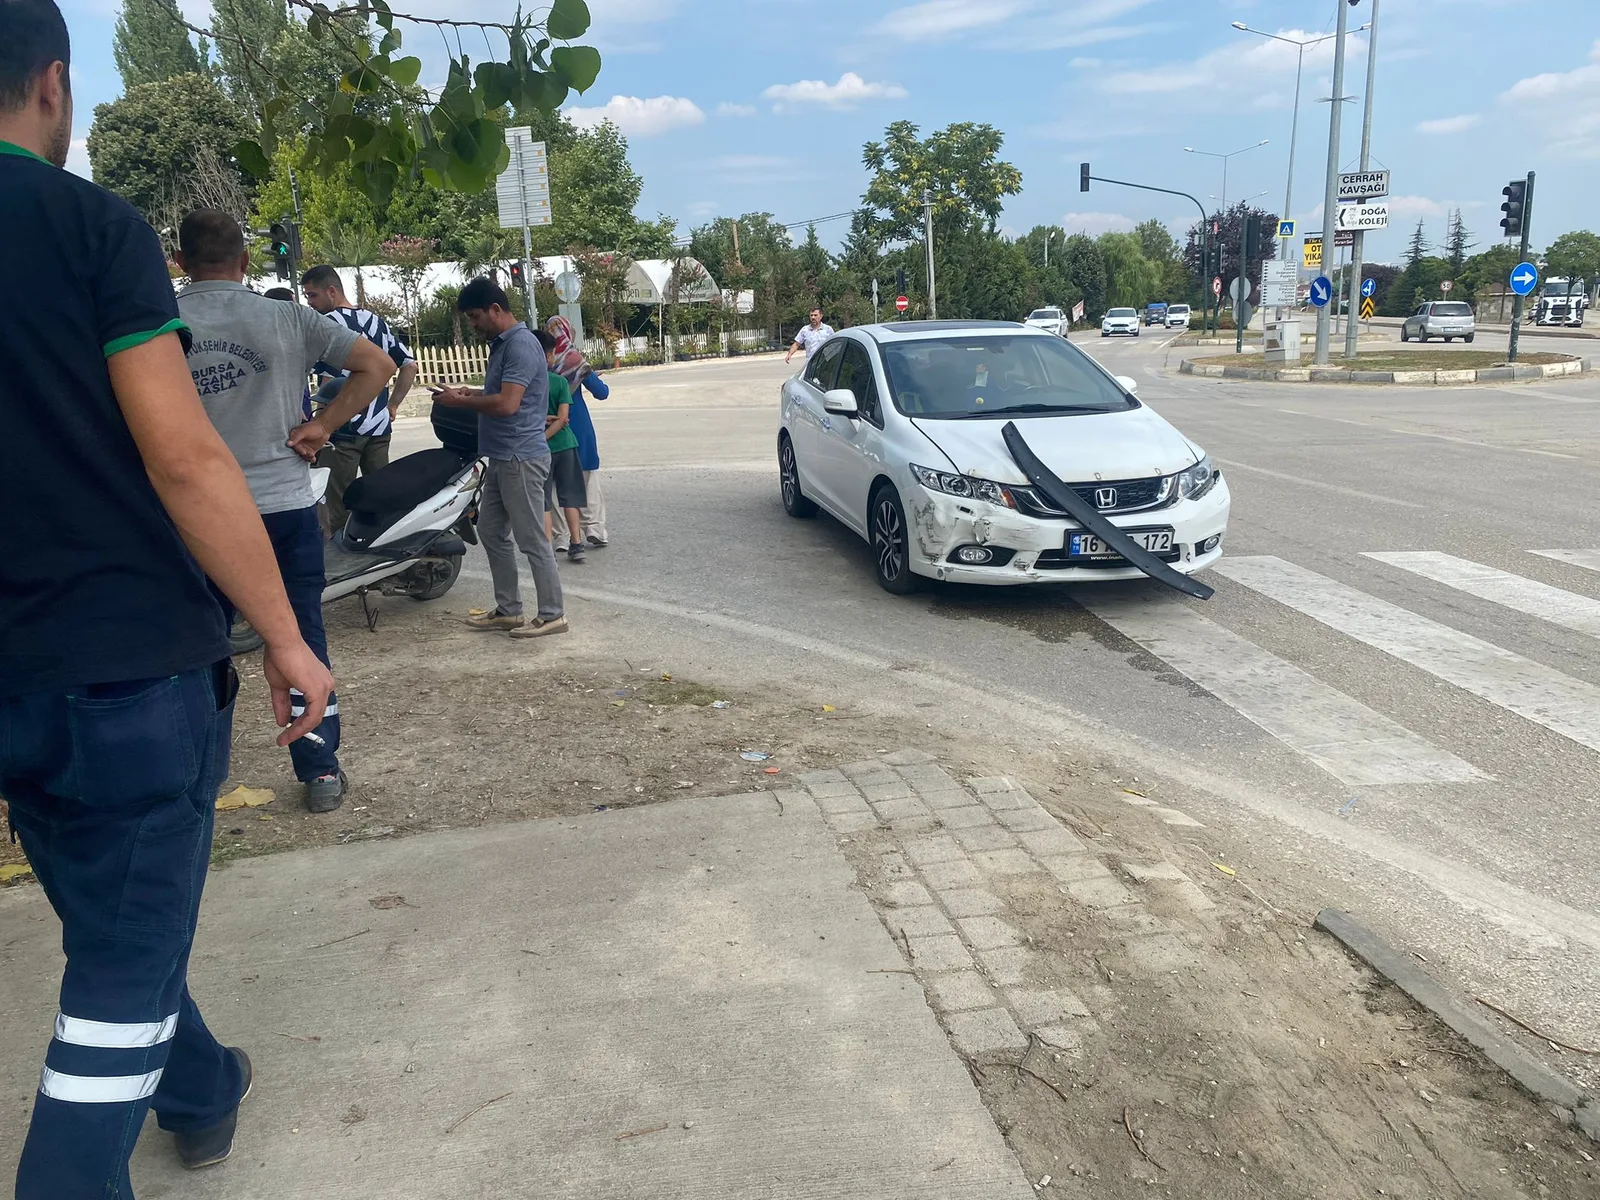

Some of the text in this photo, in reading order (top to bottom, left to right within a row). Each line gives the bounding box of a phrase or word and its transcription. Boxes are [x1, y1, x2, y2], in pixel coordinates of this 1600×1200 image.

[1342, 173, 1383, 184] CERRAH
[1339, 182, 1385, 195] KAVŞAĞI
[1361, 206, 1387, 216] DOĞA
[1358, 215, 1388, 226] KOLEJİ
[186, 338, 228, 358] ÜKŞEHİR
[192, 361, 235, 380] BURSA
[200, 368, 247, 387] CANLA
[1081, 536, 1099, 553] 16
[1143, 533, 1170, 550] 172
